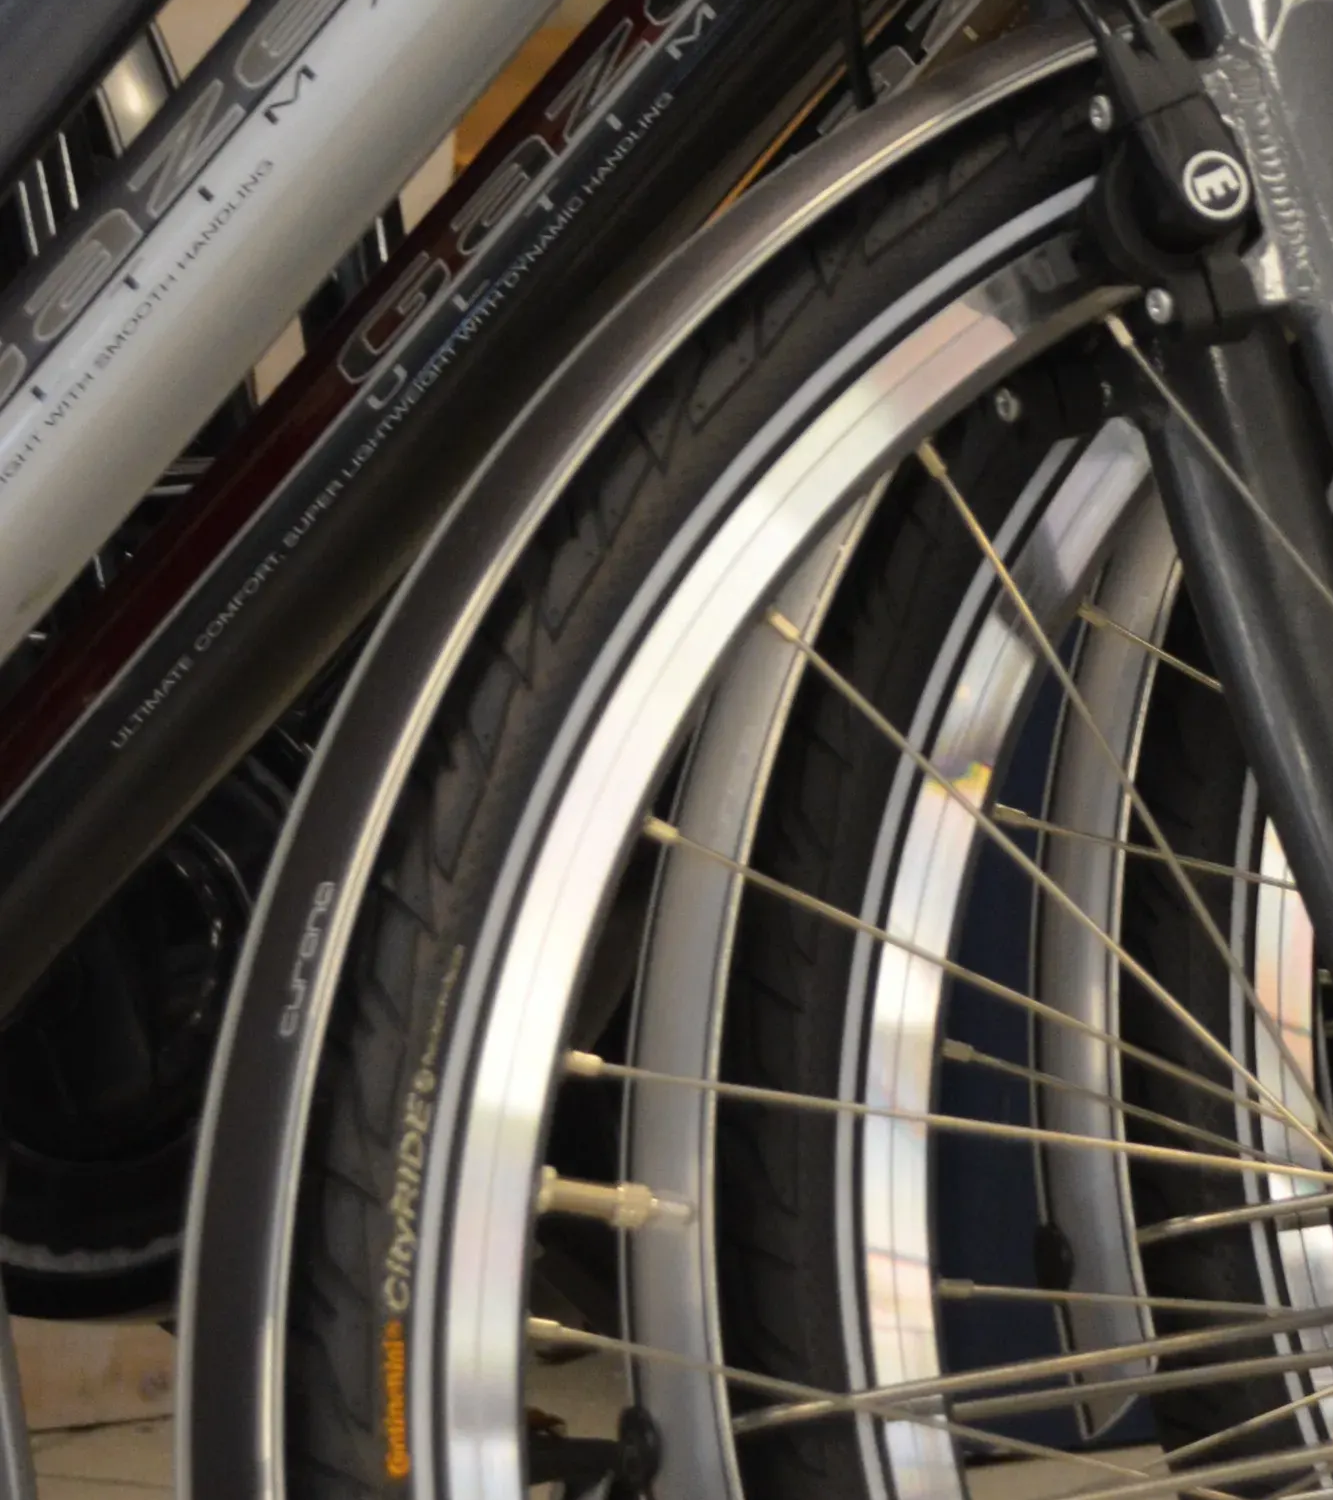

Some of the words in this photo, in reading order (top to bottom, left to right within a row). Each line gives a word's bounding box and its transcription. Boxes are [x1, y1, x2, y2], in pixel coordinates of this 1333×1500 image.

[0, 432, 42, 485] IGHT
[44, 371, 95, 428] WITH
[93, 272, 178, 370] SMOOTH
[175, 159, 274, 270] HANDLING
[110, 653, 195, 750] ULTIMATE
[282, 477, 345, 550] SUPER
[455, 282, 504, 342] WITH
[502, 196, 584, 289] DYNAMIC
[585, 91, 674, 195] HANDLING
